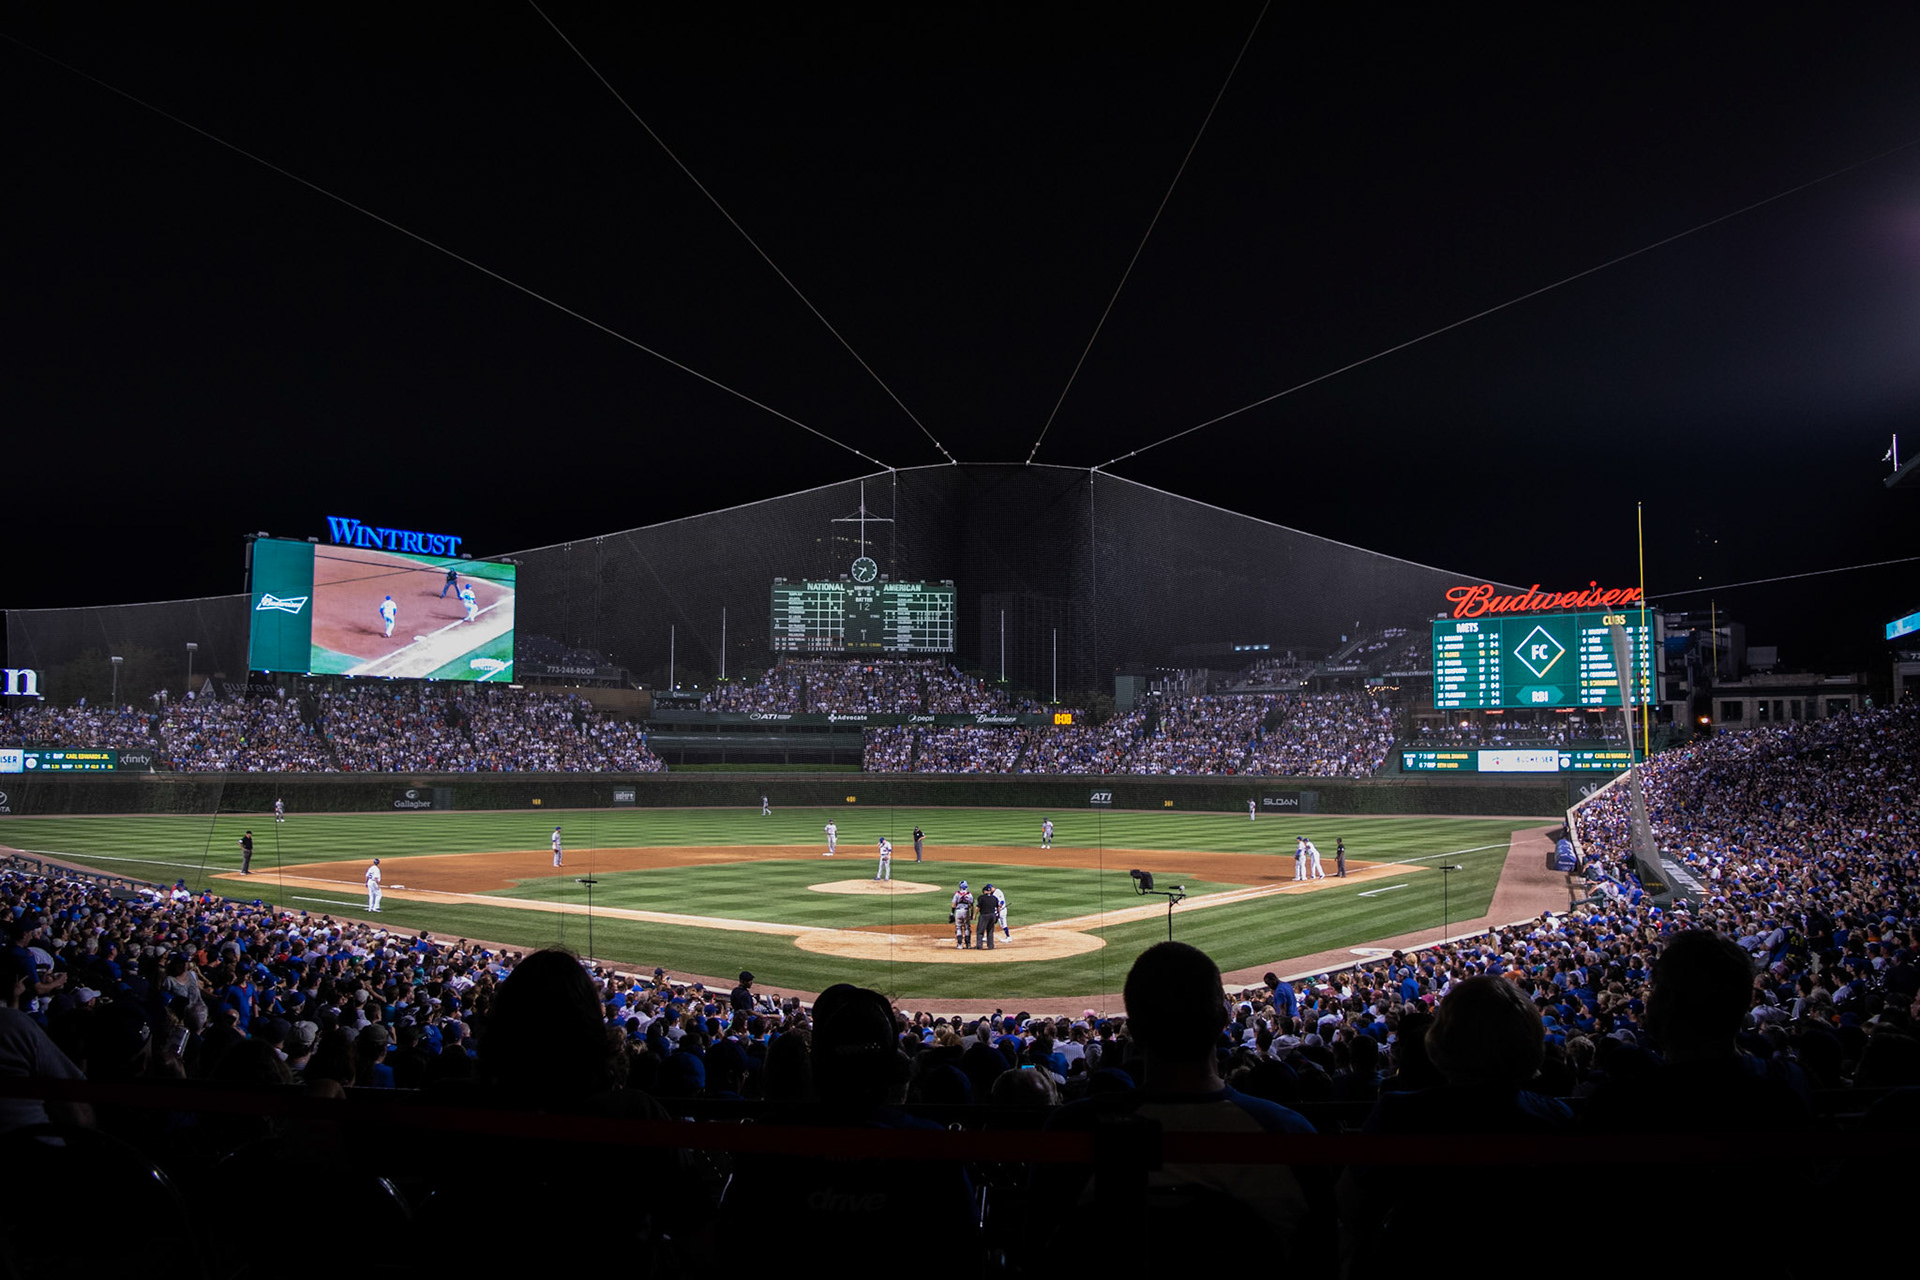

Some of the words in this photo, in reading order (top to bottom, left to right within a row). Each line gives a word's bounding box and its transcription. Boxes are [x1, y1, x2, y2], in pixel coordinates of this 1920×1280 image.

[807, 583, 845, 591] NATIONAL
[883, 584, 922, 592] AMERICAN
[1446, 580, 1642, 618] Budweiser
[1603, 615, 1626, 626] CUBS
[1456, 622, 1479, 633] METS
[1532, 644, 1548, 660] FC
[0, 668, 40, 696] n
[917, 715, 935, 723] pepsi
[975, 714, 1017, 723] Budweiser
[1054, 713, 1072, 725] 0:08
[120, 753, 151, 766] xfinity
[1090, 793, 1112, 801] ATI
[1263, 798, 1298, 806] SLOAN
[394, 800, 431, 809] Gallagher
